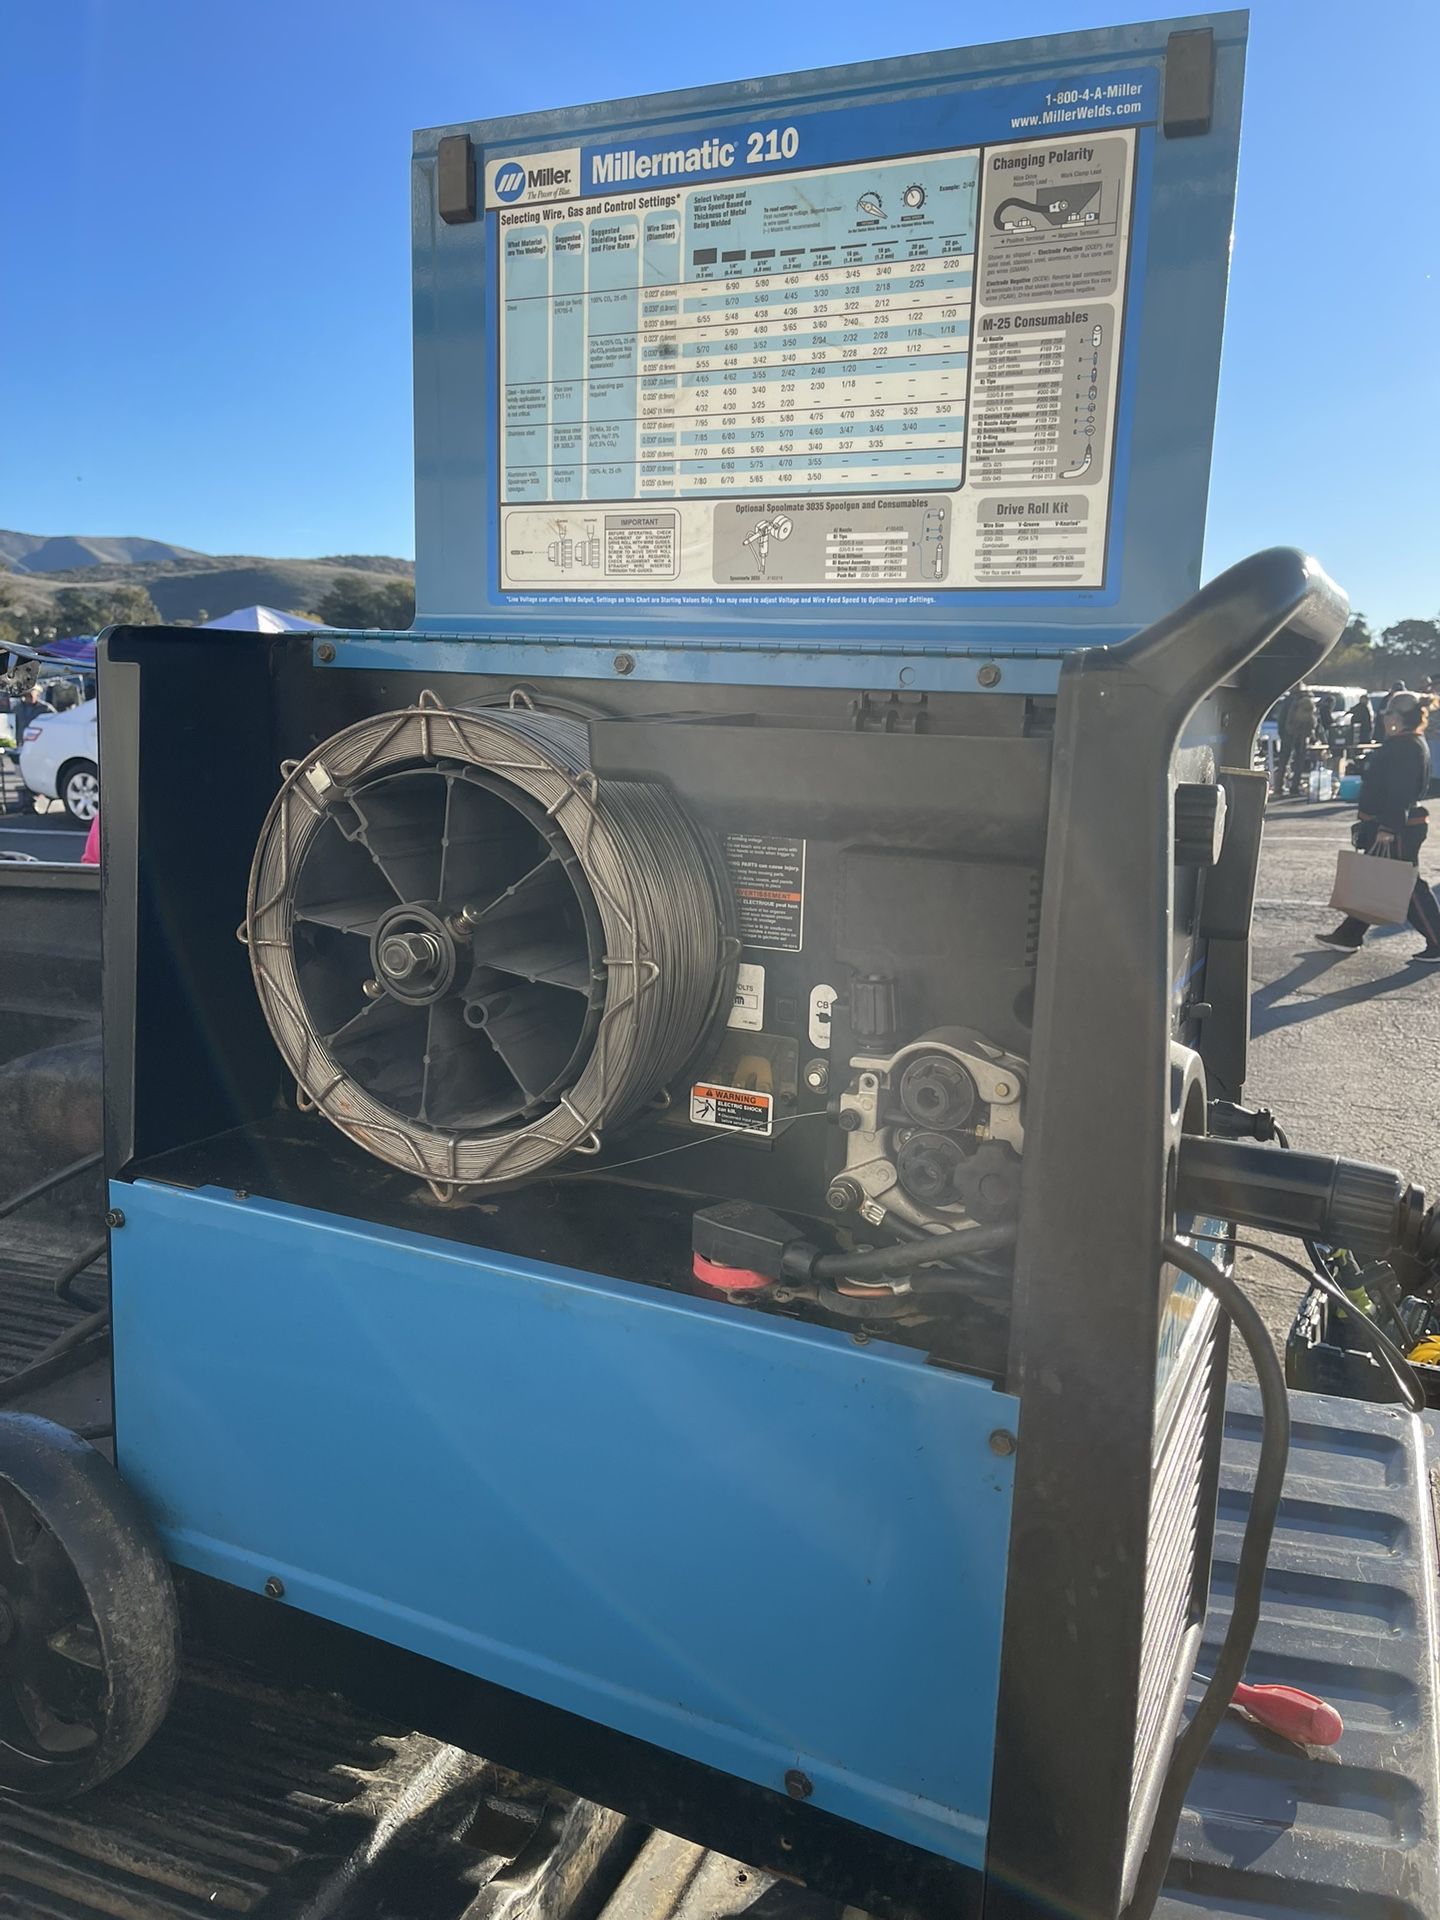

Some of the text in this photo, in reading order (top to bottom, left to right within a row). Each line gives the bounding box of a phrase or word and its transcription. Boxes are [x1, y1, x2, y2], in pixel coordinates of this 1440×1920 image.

[1046, 83, 1142, 106] 1-800-4-A-Miller
[1011, 102, 1142, 128] www.MillerWelds.com
[592, 127, 799, 184] Millermatic 210
[993, 148, 1094, 170] Changing Polarity
[694, 195, 712, 204] Select
[714, 193, 734, 202] Voltage
[501, 211, 540, 226] Selecting
[543, 209, 565, 221] Wire,
[568, 206, 583, 217] Gas
[586, 203, 601, 215] and
[604, 200, 636, 213] Control
[708, 202, 725, 212] Speed
[694, 212, 721, 220] Thickness
[730, 208, 746, 216] Metal
[647, 223, 675, 232] Wire Sizes
[694, 219, 731, 230] Being Welded
[591, 227, 620, 237] Suggested
[647, 231, 676, 242] (Diameter)
[521, 238, 542, 247] Material
[555, 234, 581, 244] Suggested
[591, 235, 617, 245] Shielding
[555, 242, 581, 251] Wire Types
[815, 272, 829, 282] 4/55
[846, 269, 860, 279] 3/45
[876, 266, 891, 276] 3/40
[910, 262, 925, 272] 2/22
[944, 259, 959, 269] 2/20
[784, 278, 924, 300] 4/45 3/30 2/18 2/25
[813, 298, 890, 313] 3/25 3/22 2/12
[844, 317, 858, 327] 2/40
[874, 314, 889, 324] 2/35
[908, 311, 923, 321] 1/22
[941, 308, 956, 318] 1/20
[983, 312, 1088, 330] M-25 Consumables
[843, 325, 955, 342] 2/32 2/28 1/18 1/18
[782, 352, 796, 362] 3/40
[812, 350, 826, 360] 3/35
[842, 348, 857, 358] 2/28
[873, 345, 888, 355] 2/22
[906, 343, 921, 353] 1/12
[781, 364, 856, 378] 2/42 2/40 1/20
[781, 383, 795, 393] 2/32
[810, 381, 825, 391] 2/30
[841, 379, 856, 389] 1/18
[780, 398, 795, 408] 2/20
[809, 411, 824, 421] 4/75
[840, 410, 854, 420] 4/70
[870, 408, 885, 418] 3/52
[903, 406, 918, 416] 3/52
[936, 404, 951, 414] 3/50
[779, 421, 918, 438] 5/70 3/47 3/45 3/40
[808, 439, 883, 452] 3/40 3/37 3/35
[778, 456, 822, 468] 4/70 3/55
[807, 472, 821, 482] 3/50
[736, 499, 928, 513] Optional Spoolmate 3035 Spoolgun and Consumables
[997, 502, 1068, 515] Drive Roll Kit
[842, 596, 860, 604] Speed
[868, 596, 894, 604] Optimize
[816, 1001, 829, 1009] CB
[715, 1090, 756, 1104] WARNING
[718, 1101, 762, 1113] ELECTRIC SHOCK
